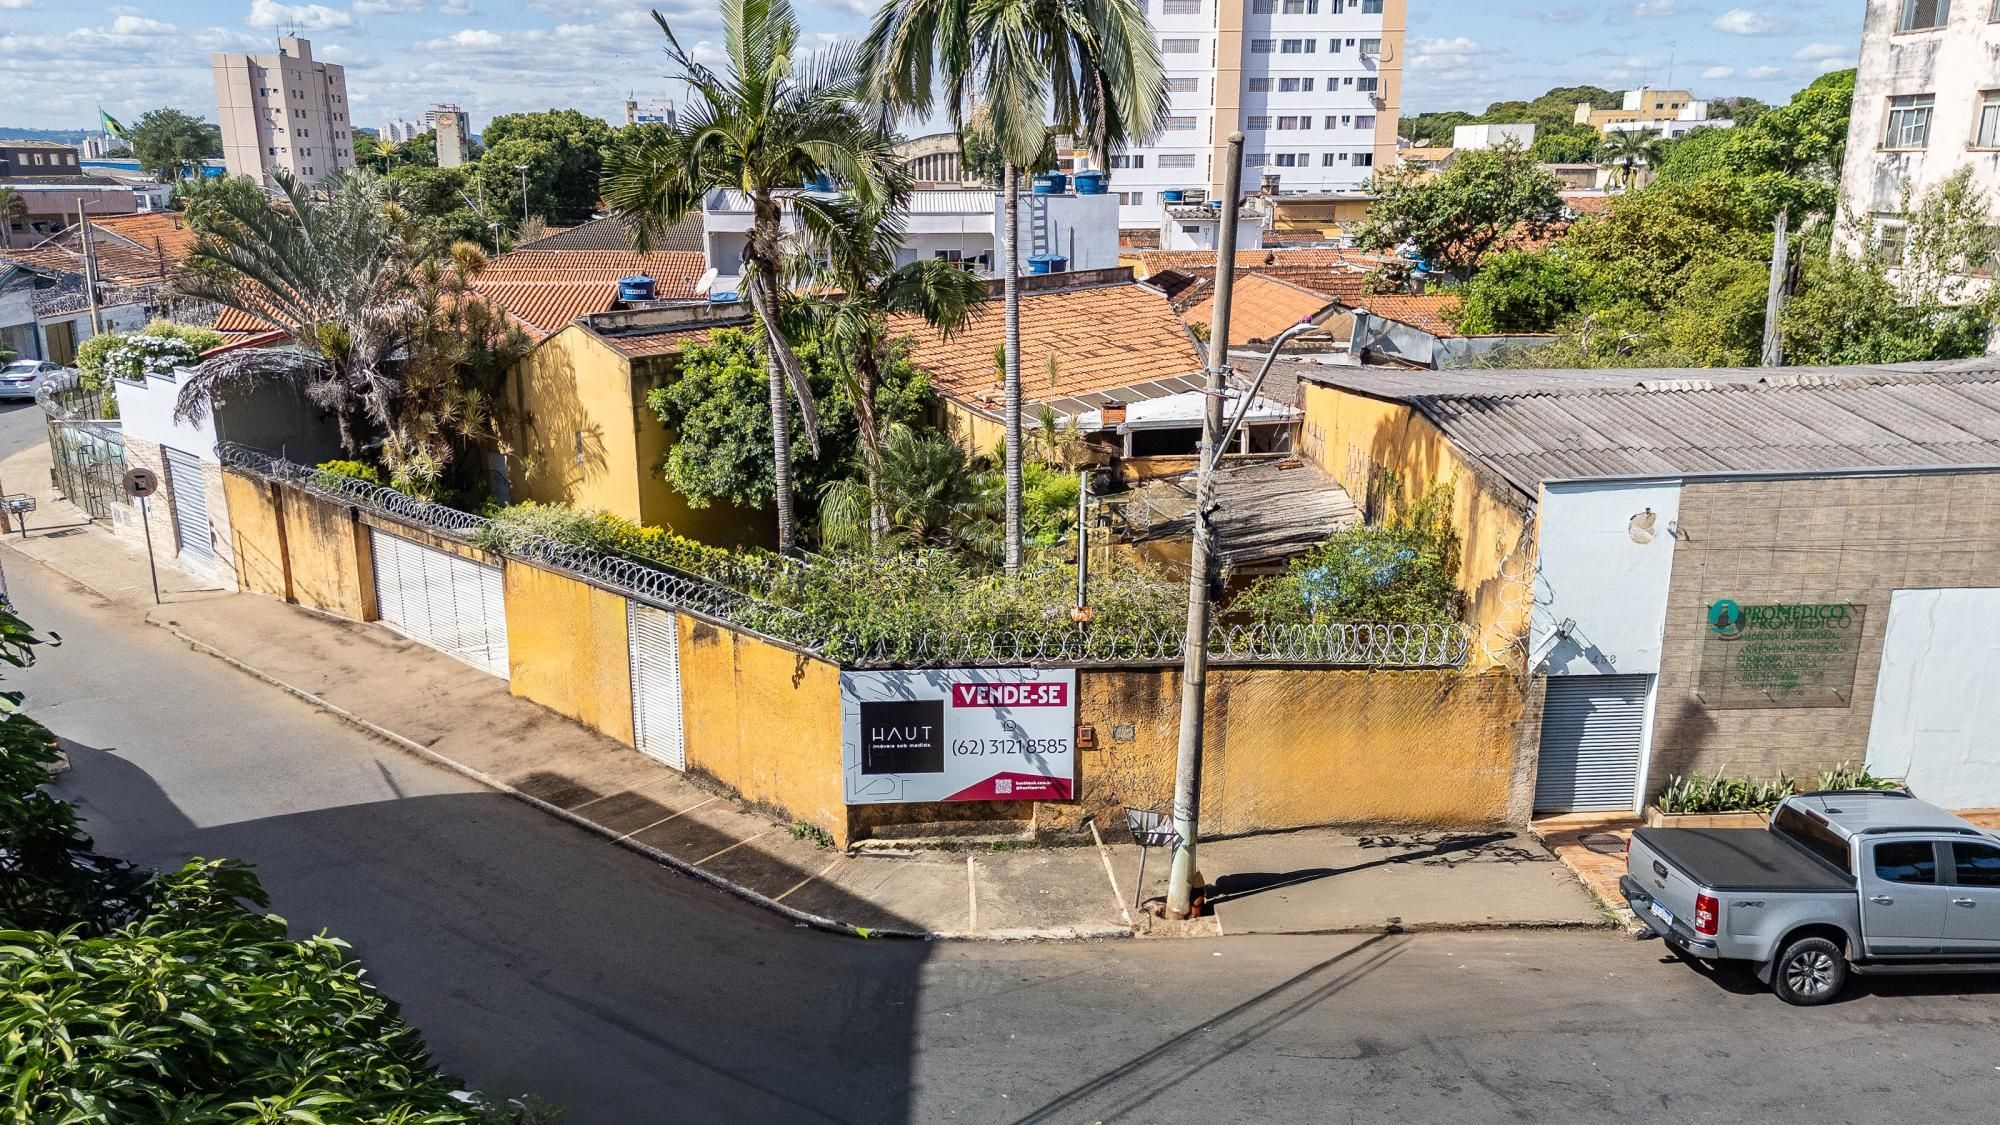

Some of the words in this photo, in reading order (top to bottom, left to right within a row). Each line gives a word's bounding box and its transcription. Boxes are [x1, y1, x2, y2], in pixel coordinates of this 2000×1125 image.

[960, 685, 1061, 705] VENDE-SE
[872, 726, 932, 742] HAUT
[952, 739, 985, 757] (62)
